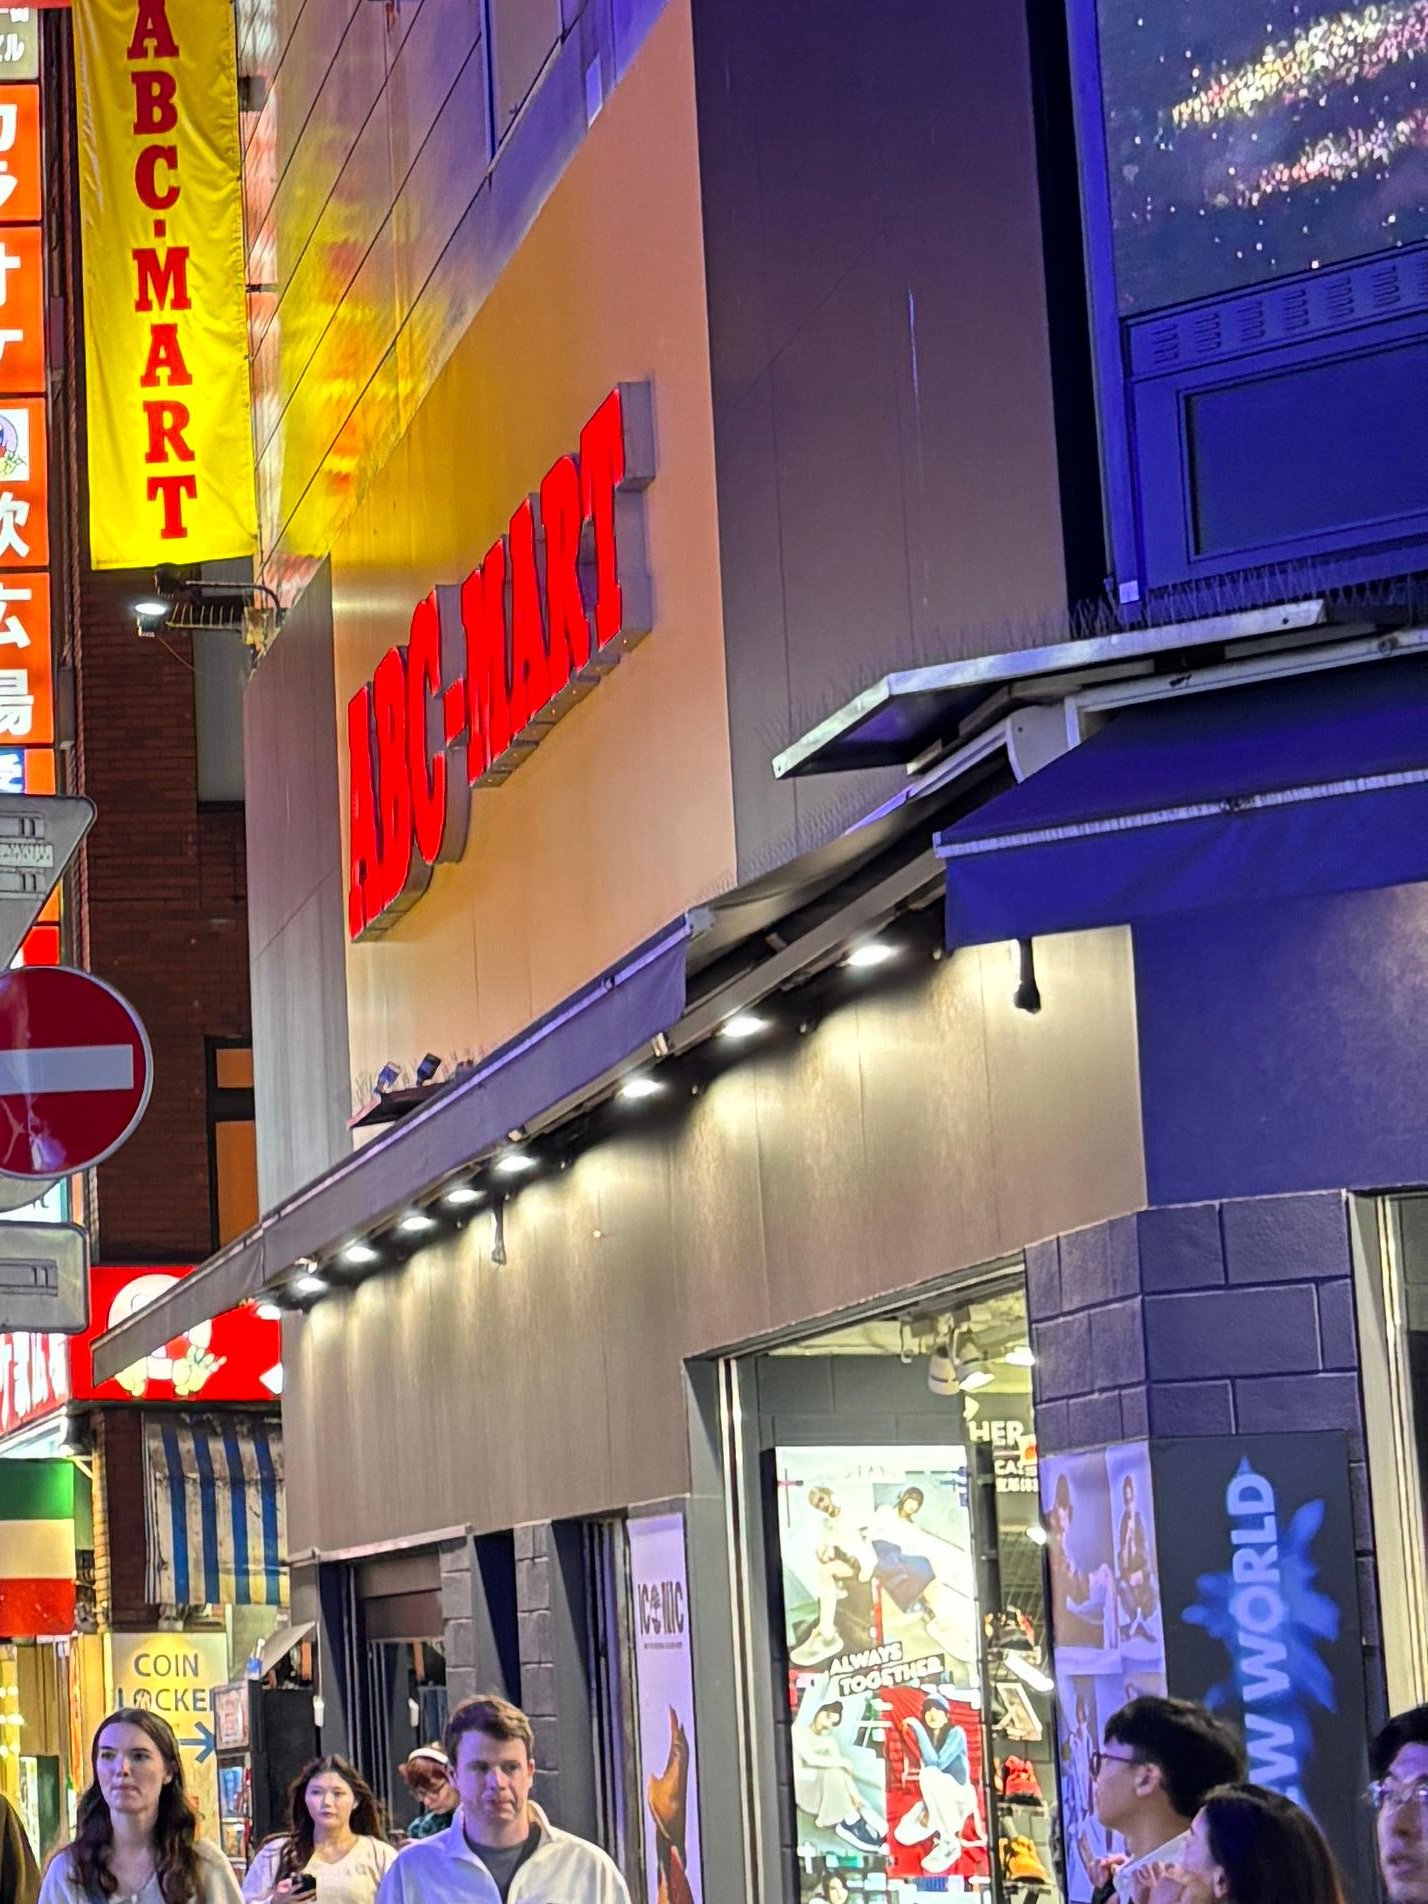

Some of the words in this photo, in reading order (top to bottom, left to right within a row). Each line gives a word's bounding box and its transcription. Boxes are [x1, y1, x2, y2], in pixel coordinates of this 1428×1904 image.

[348, 388, 626, 942] ABC-MART
[1226, 1473, 1292, 1691] WORLD
[133, 1652, 200, 1678] COIN
[829, 1641, 903, 1675] ALWAYS
[838, 1655, 945, 1696] TOGETHER
[117, 1687, 213, 1713] LOCKE
